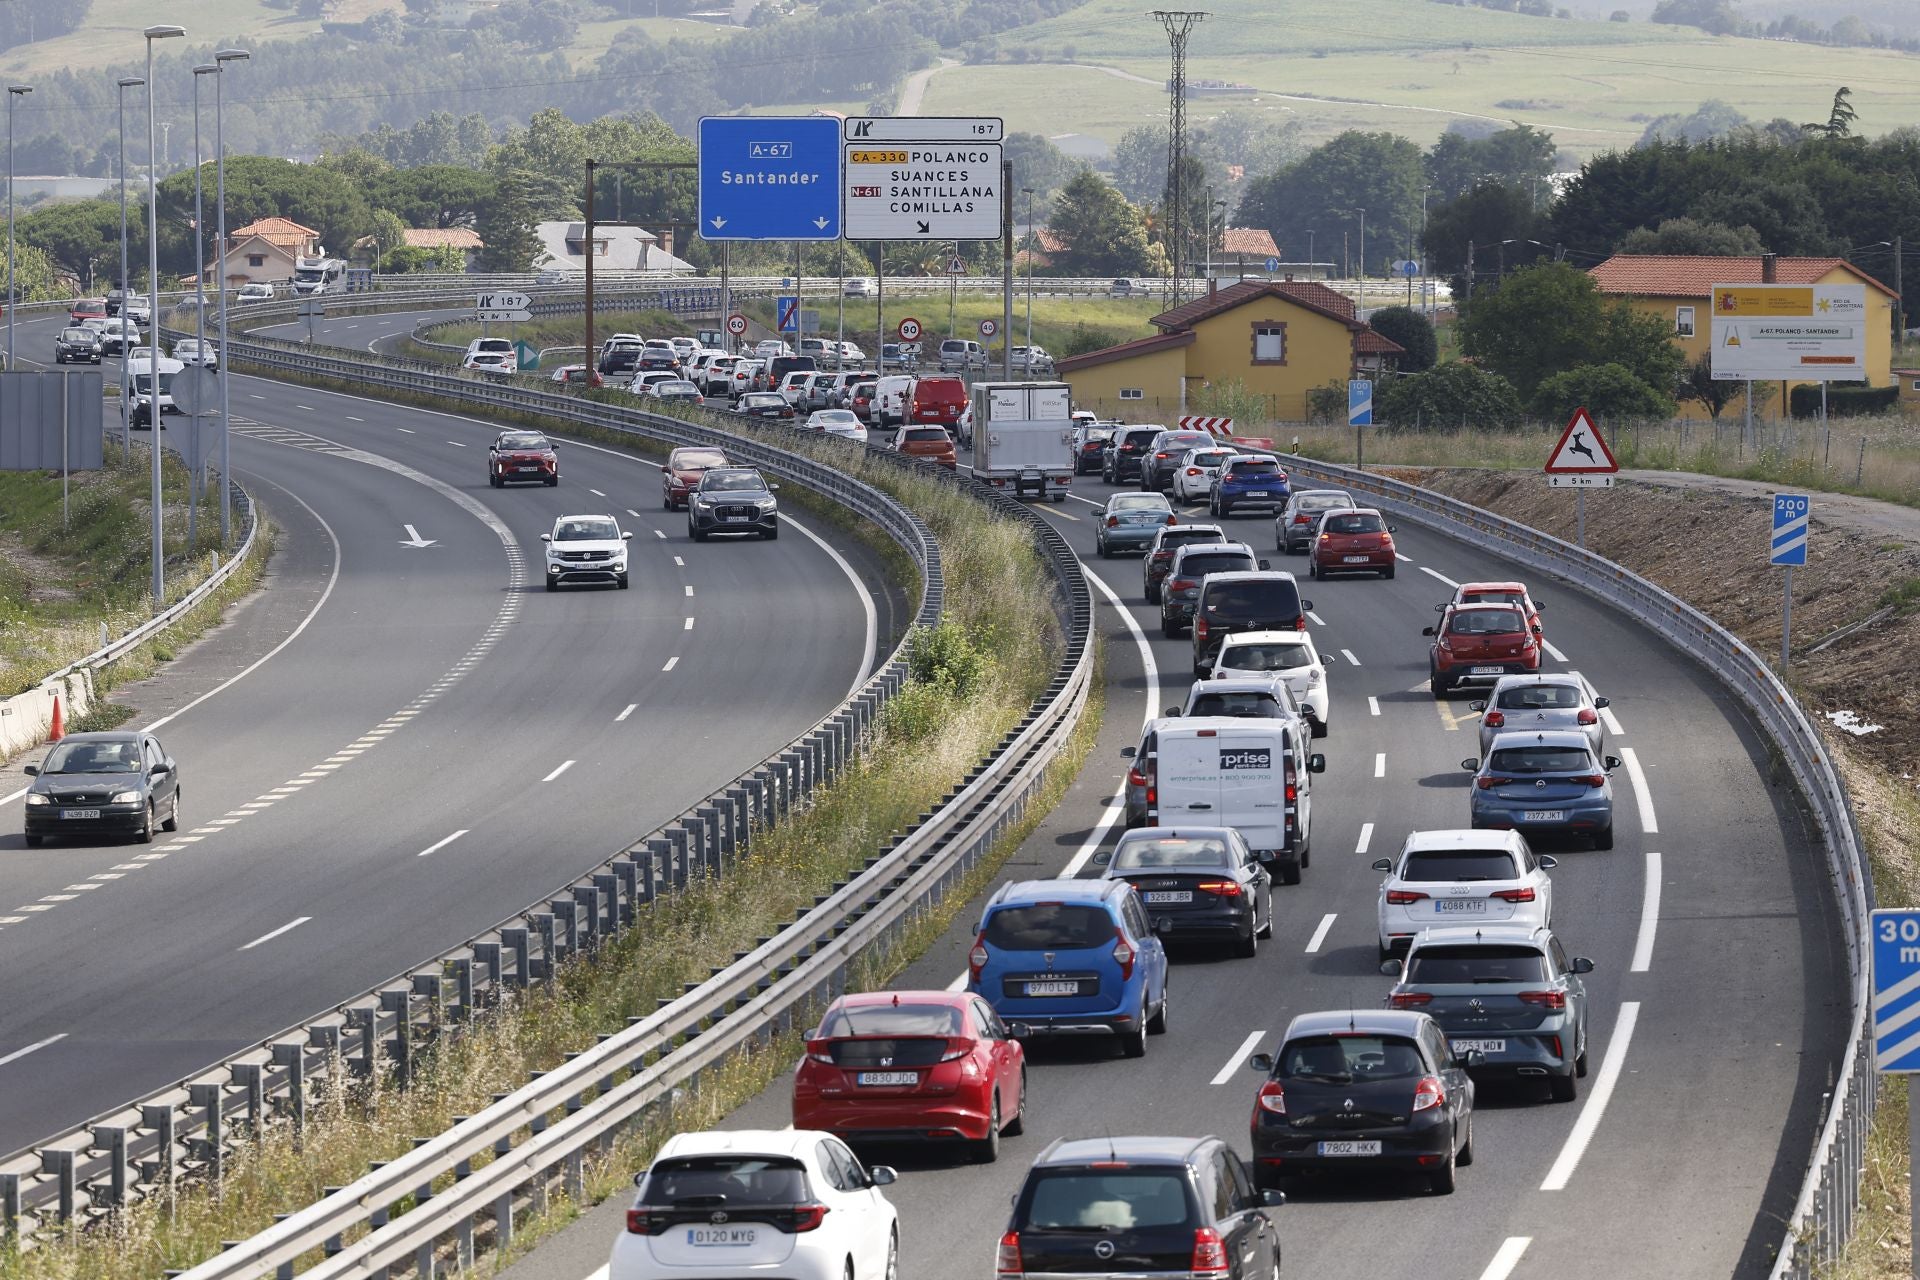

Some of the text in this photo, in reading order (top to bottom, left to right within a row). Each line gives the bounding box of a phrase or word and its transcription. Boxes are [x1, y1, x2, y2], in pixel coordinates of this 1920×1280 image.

[972, 125, 994, 134] 187
[753, 144, 789, 155] A-67
[852, 152, 989, 162] CA-330 POLANCO
[721, 170, 820, 184] Santander
[891, 171, 969, 181] SUANCES
[851, 187, 881, 197] N-611
[890, 187, 994, 197] SANTILLANA
[890, 202, 974, 213] COMILLAS
[501, 297, 522, 306] 187
[730, 320, 744, 329] 60
[903, 325, 916, 334] 90
[1777, 499, 1805, 510] 200
[85, 810, 98, 818] BZP
[1527, 812, 1560, 820] 2372 JKT
[1151, 893, 1190, 901] 3268 JBR
[1442, 901, 1483, 910] 4088 KTF
[1900, 947, 1920, 963] m
[1031, 983, 1076, 992] 9710 LTZ
[1455, 1041, 1480, 1050] 2753
[865, 1073, 916, 1083] 8830 JDC
[1326, 1143, 1376, 1153] 7802 HKK
[695, 1231, 755, 1242] 0120 MYG
